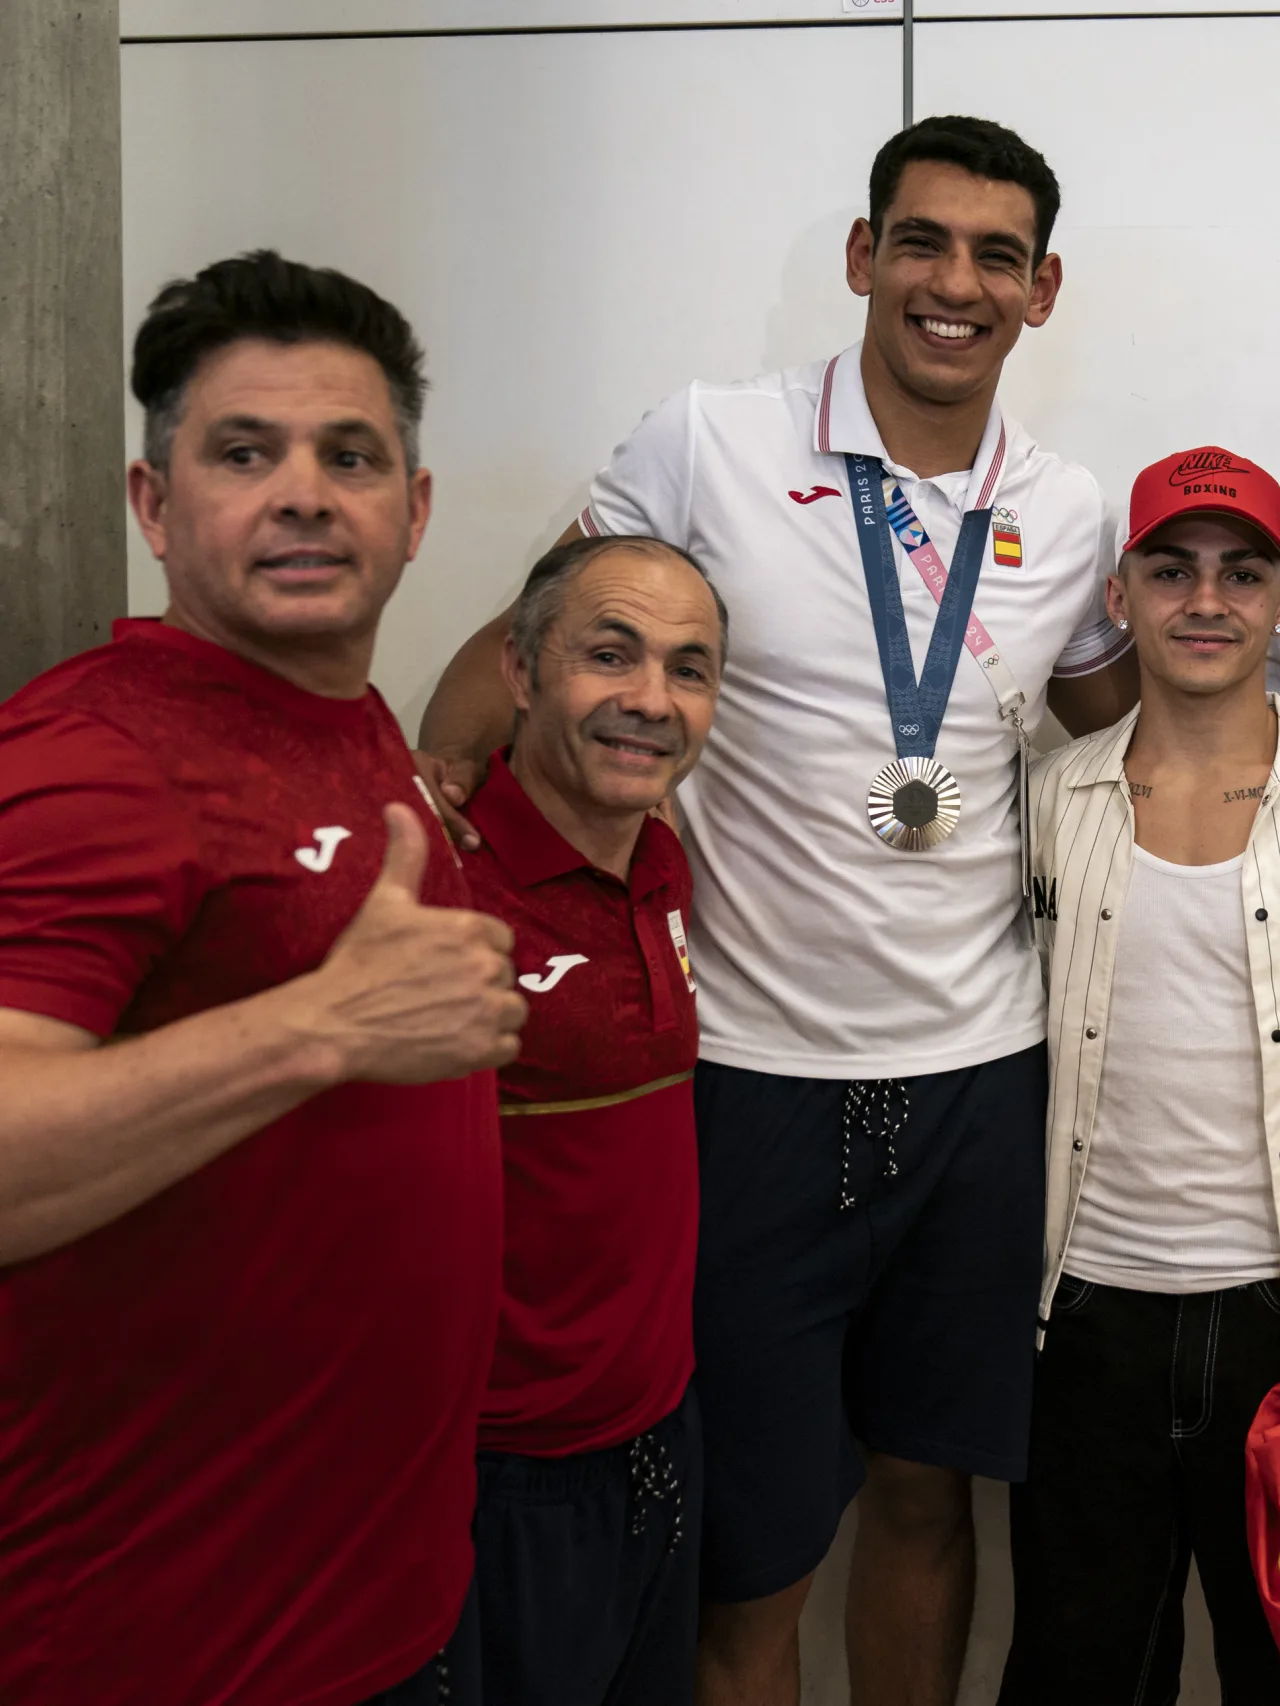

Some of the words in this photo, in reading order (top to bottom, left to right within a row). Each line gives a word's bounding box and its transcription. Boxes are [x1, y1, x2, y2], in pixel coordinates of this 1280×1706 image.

[1181, 452, 1233, 471] NIKE
[1183, 483, 1238, 498] BOXING
[1223, 785, 1266, 803] X-VI-MC
